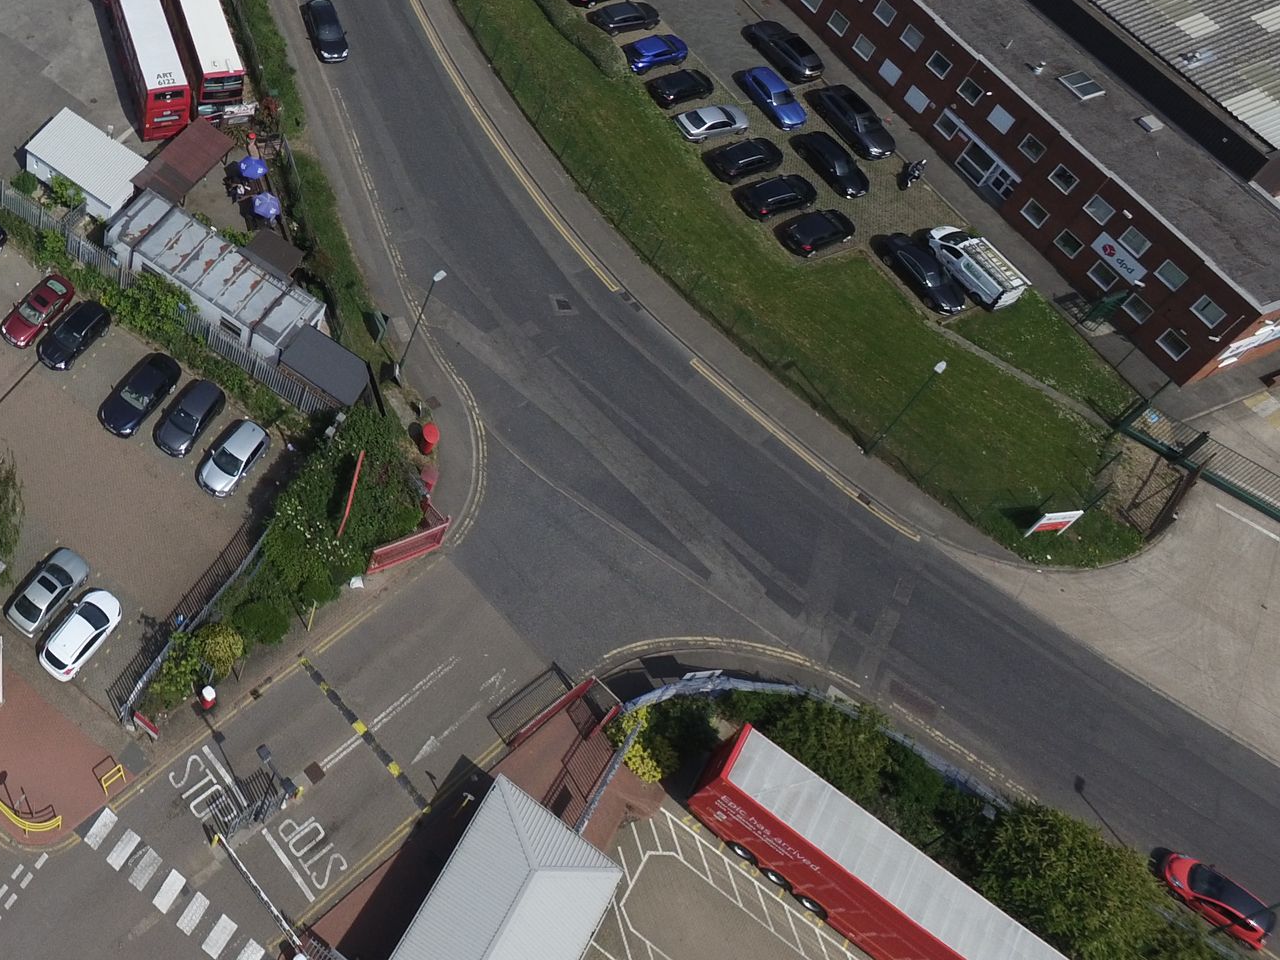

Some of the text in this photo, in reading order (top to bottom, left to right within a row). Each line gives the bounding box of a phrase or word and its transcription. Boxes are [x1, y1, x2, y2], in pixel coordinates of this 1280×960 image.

[156, 72, 173, 80] ART
[157, 78, 177, 86] 6122
[1116, 258, 1135, 274] dpd
[169, 754, 238, 822] STOP
[278, 816, 348, 890] STOP
[720, 794, 747, 817] Epic
[749, 816, 771, 836] has
[774, 837, 822, 874] arrived.
